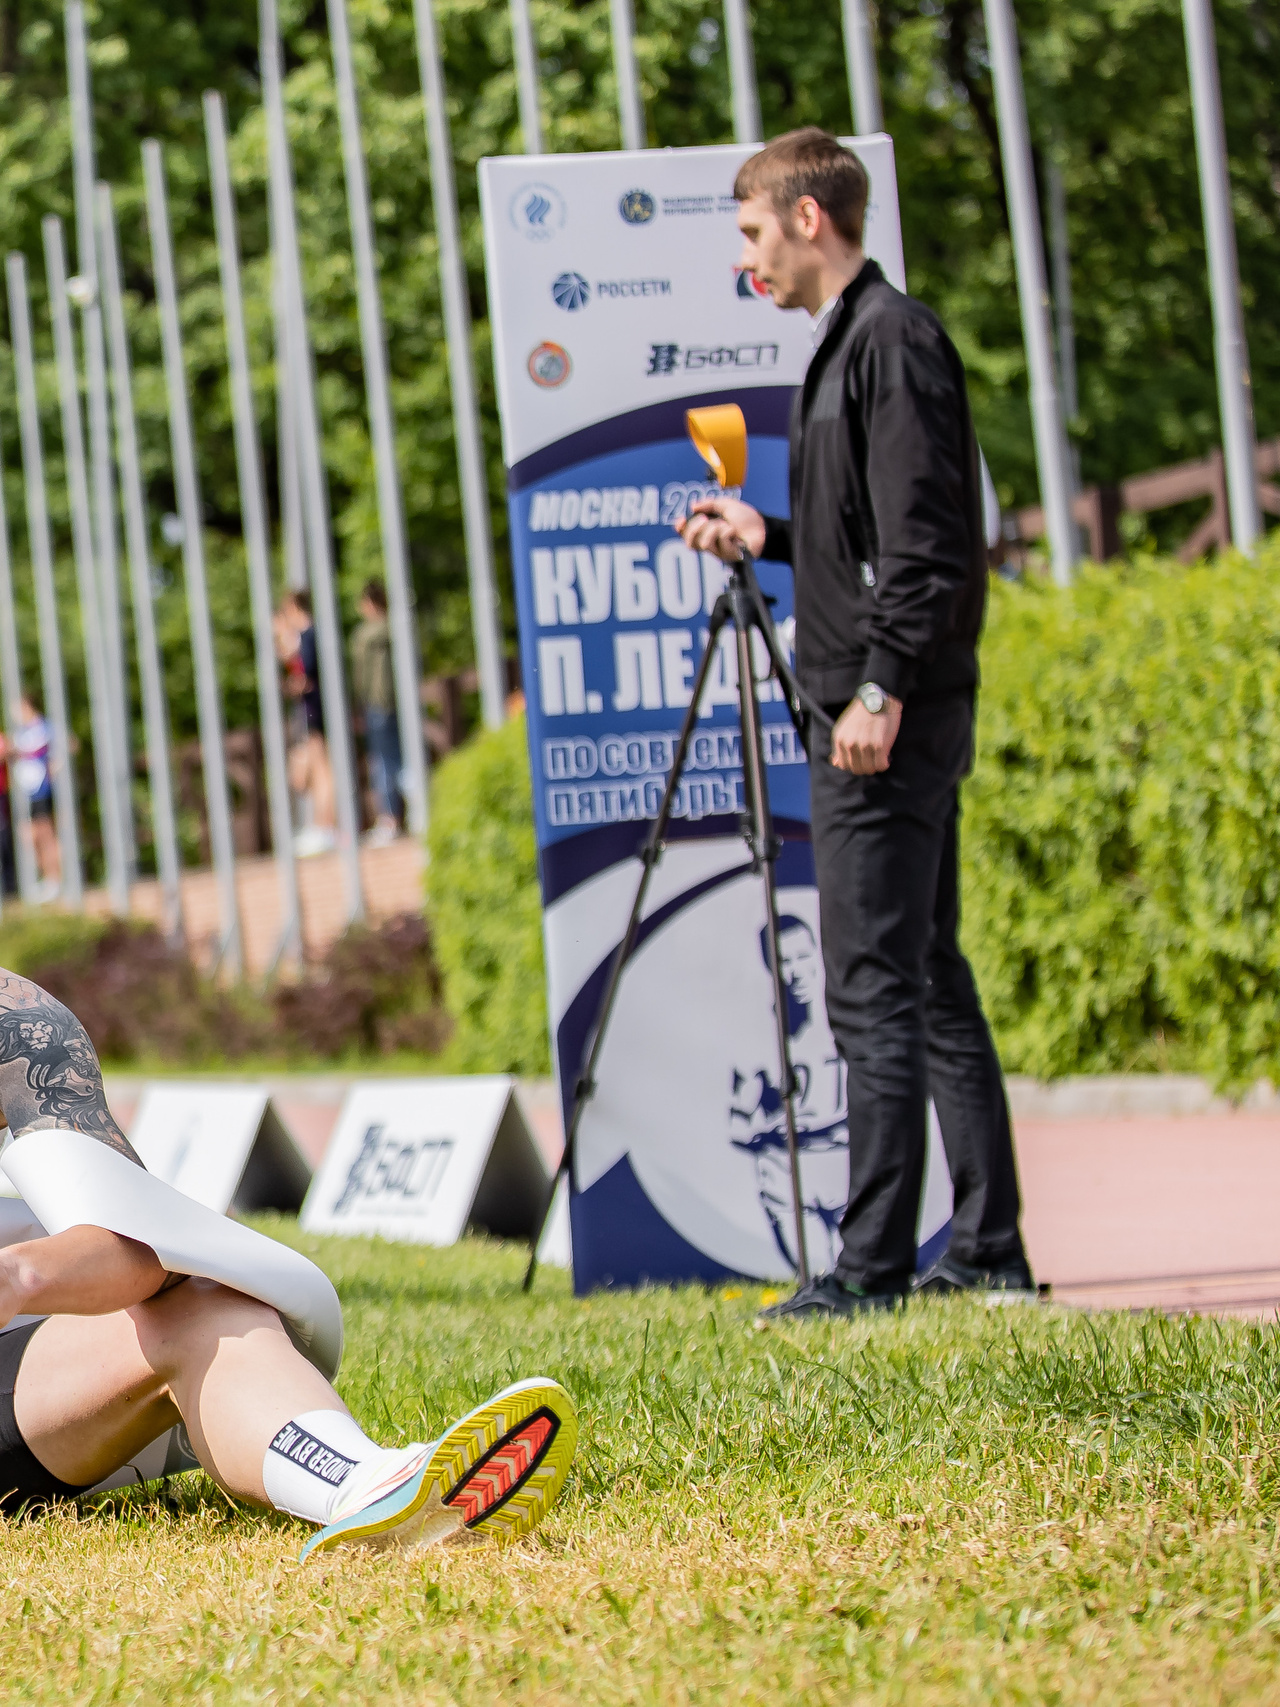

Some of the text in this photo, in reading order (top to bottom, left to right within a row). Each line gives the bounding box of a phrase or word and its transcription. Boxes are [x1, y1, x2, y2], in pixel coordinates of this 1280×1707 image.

[597, 278, 672, 299] РОССЕТИ
[529, 485, 660, 532] МОСКВА
[537, 634, 604, 717] П.
[272, 1425, 355, 1484] UNDER BY ME
